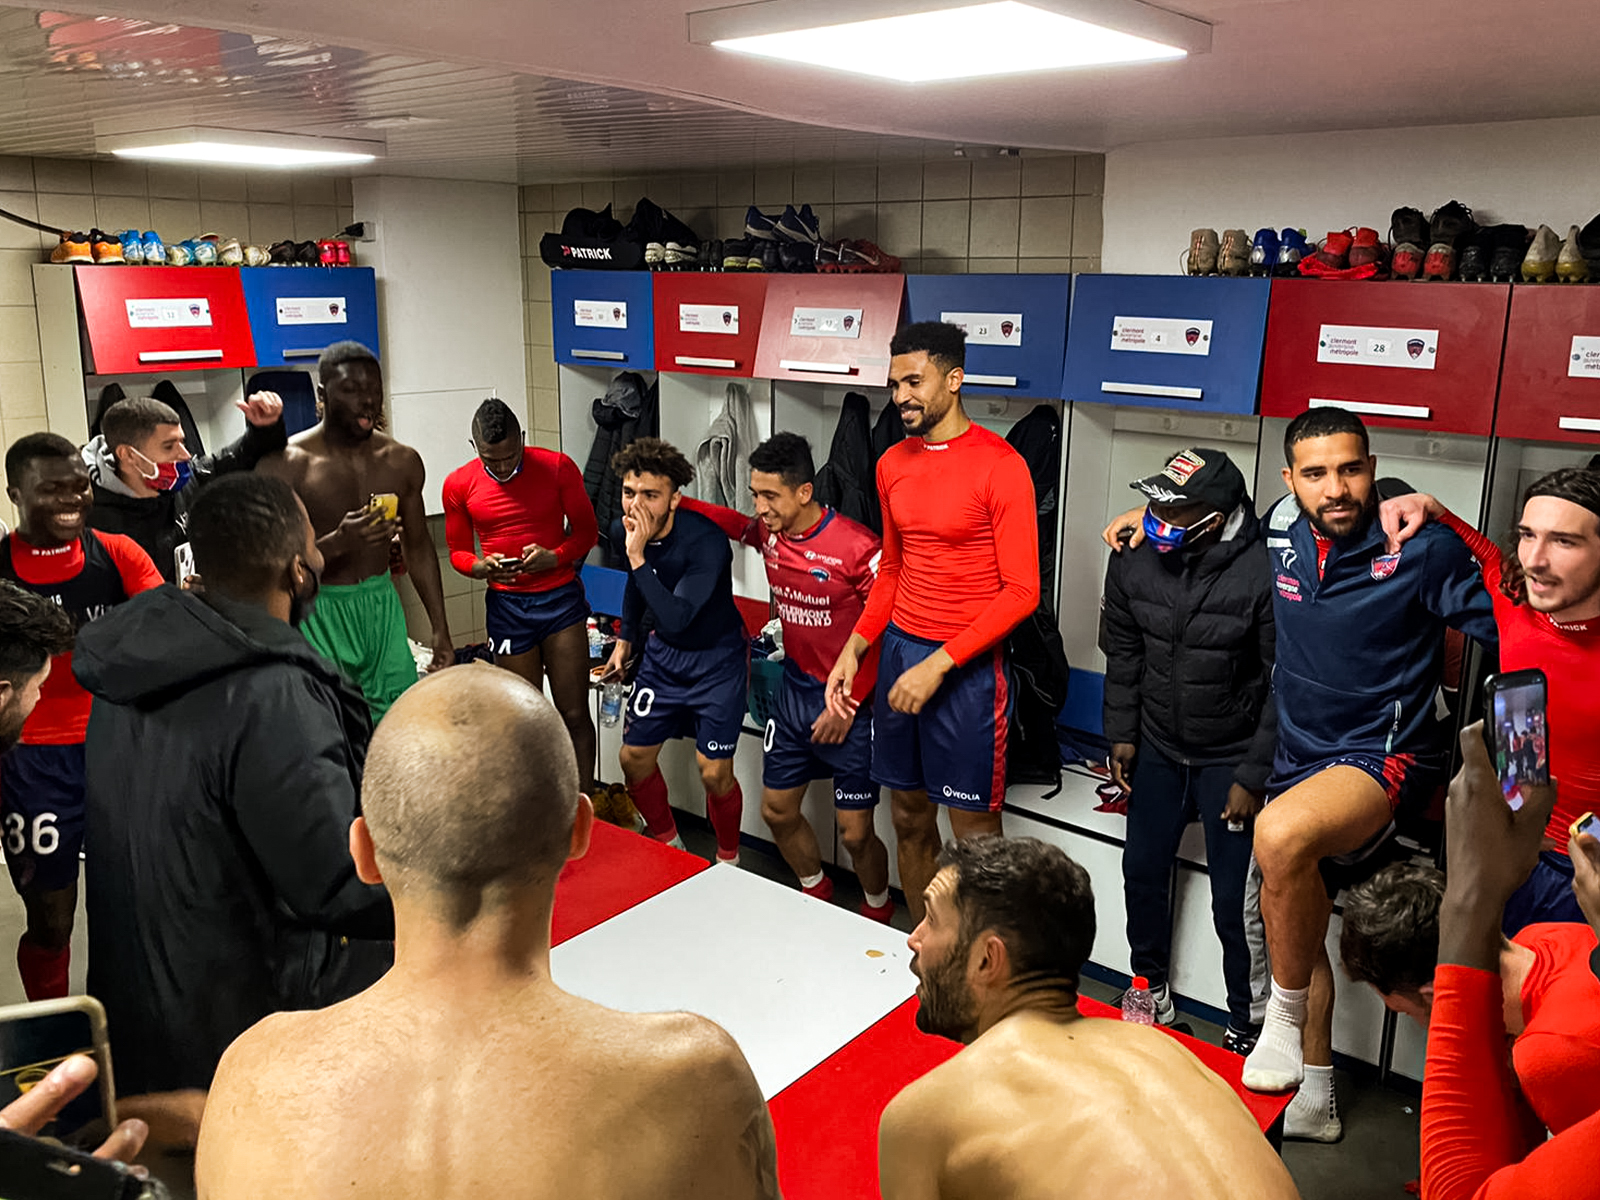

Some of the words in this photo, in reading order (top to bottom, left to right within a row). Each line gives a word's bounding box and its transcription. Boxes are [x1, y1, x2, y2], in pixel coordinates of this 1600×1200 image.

[570, 247, 612, 260] PATRICK
[978, 327, 988, 335] 23
[1330, 337, 1357, 345] clermont
[1373, 343, 1386, 353] 28
[843, 792, 872, 800] VEOLIA
[951, 790, 981, 801] VEOLIA
[5, 812, 60, 855] 36
